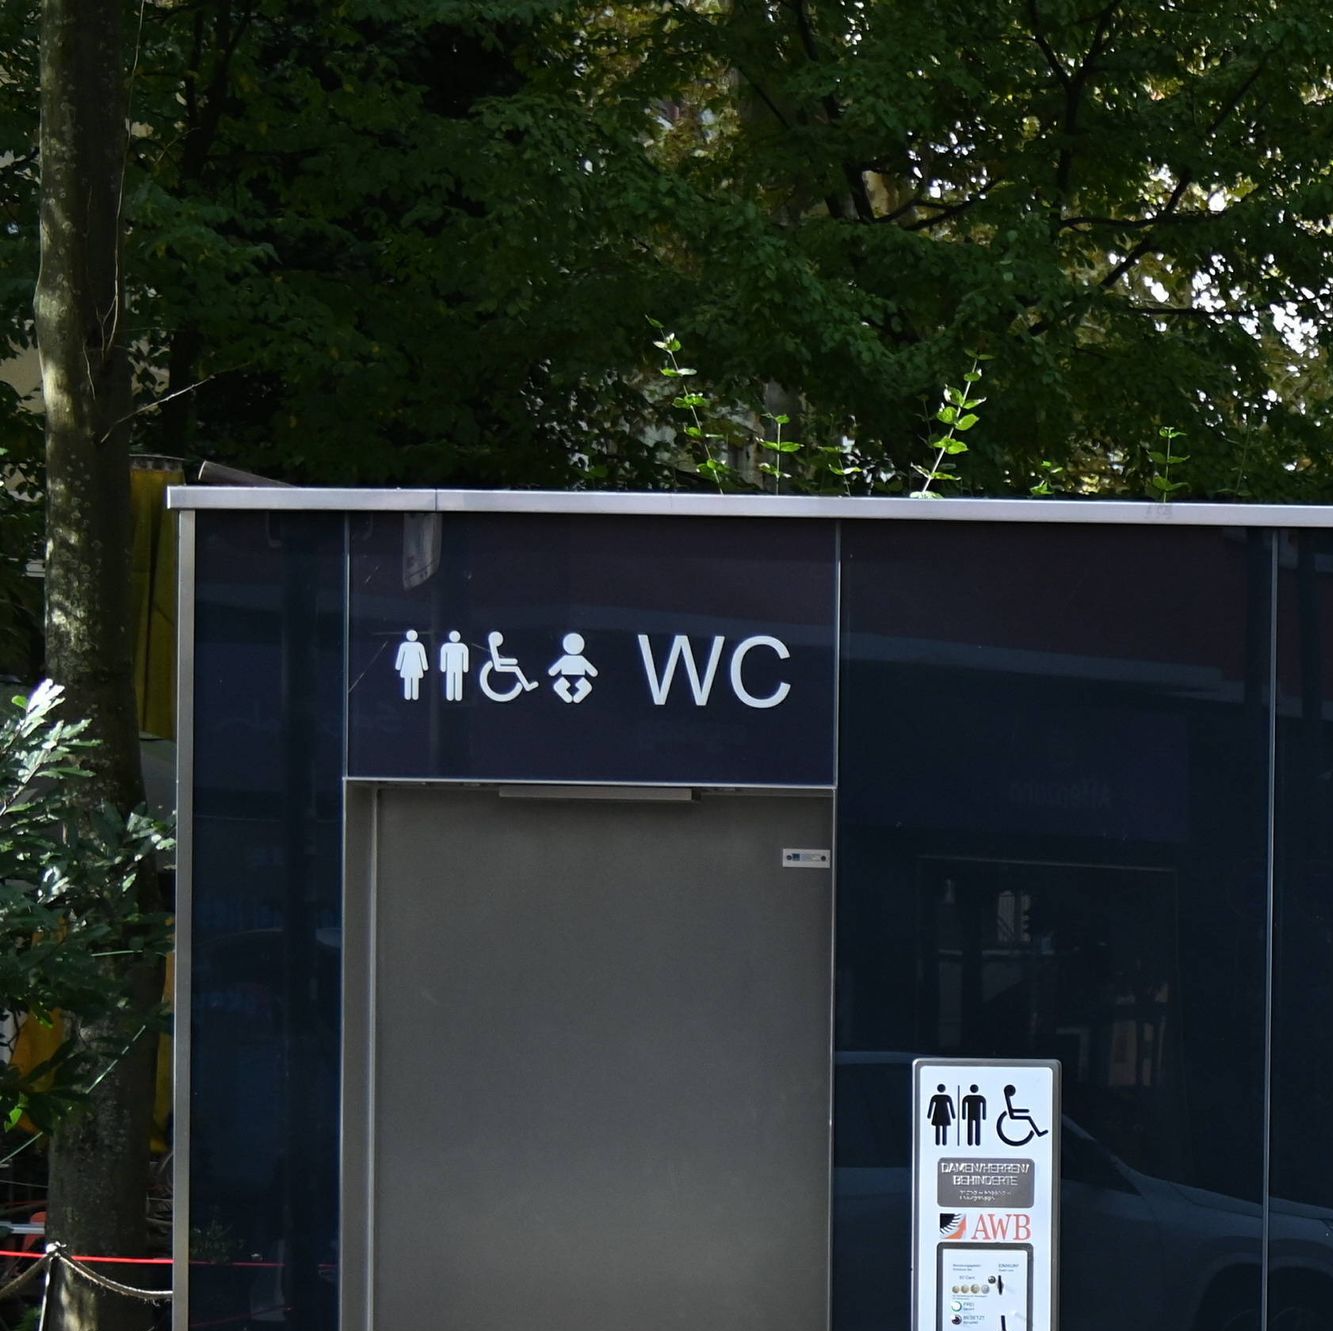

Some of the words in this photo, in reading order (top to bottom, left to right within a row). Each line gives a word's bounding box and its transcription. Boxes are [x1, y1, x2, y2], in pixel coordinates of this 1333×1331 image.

[638, 634, 791, 709] WC
[941, 1162, 1030, 1174] DAMEN/HERREN/
[953, 1175, 1018, 1186] BEHINDERTE
[971, 1213, 1032, 1241] AWB
